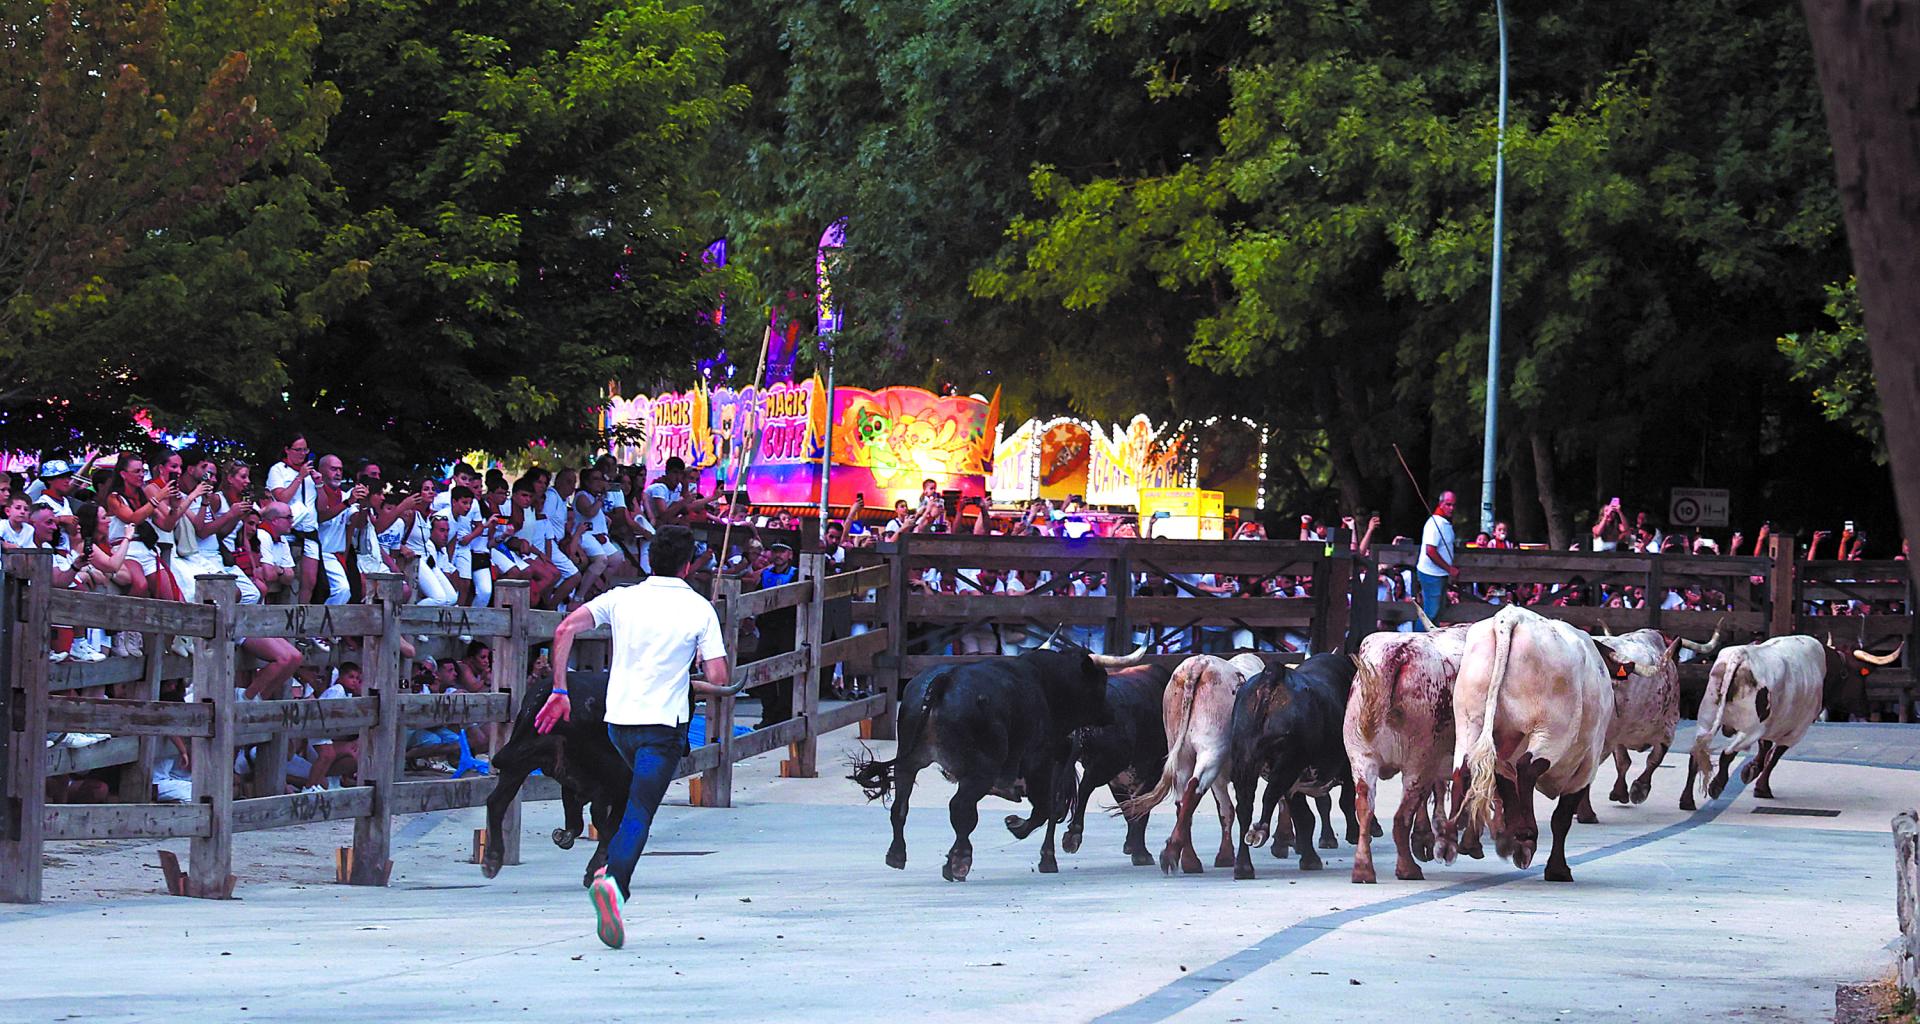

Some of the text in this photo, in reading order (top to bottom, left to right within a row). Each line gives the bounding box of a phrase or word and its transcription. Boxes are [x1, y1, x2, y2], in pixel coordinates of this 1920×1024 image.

[655, 400, 691, 426] MAGIC
[766, 390, 807, 418] MAGIC
[763, 423, 806, 458] CUTE
[1093, 451, 1130, 493] GAME
[1680, 506, 1693, 516] 10
